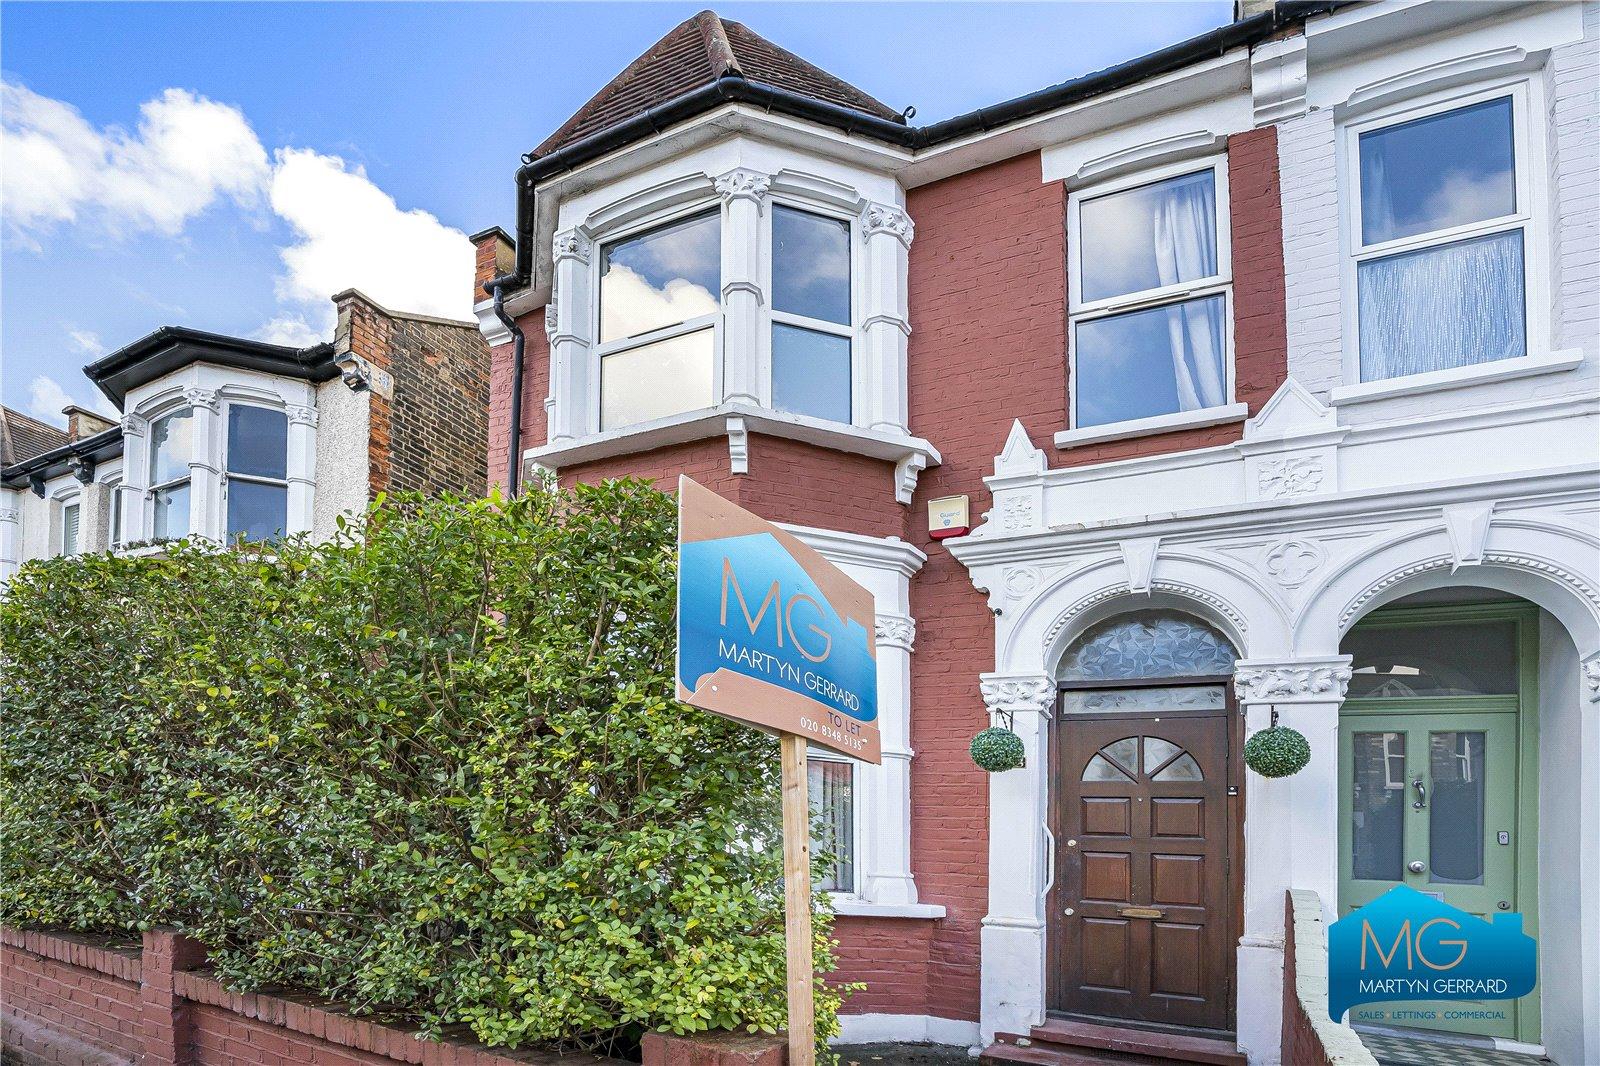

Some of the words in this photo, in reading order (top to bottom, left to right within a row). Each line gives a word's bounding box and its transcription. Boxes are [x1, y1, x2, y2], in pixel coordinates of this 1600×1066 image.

[720, 556, 832, 663] MG
[719, 638, 800, 684] MARTYN
[803, 670, 860, 711] GERRARD
[800, 717, 818, 733] 020
[821, 725, 842, 743] 8348
[844, 734, 862, 751] 5135
[827, 710, 843, 728] TO
[845, 719, 862, 737] LET
